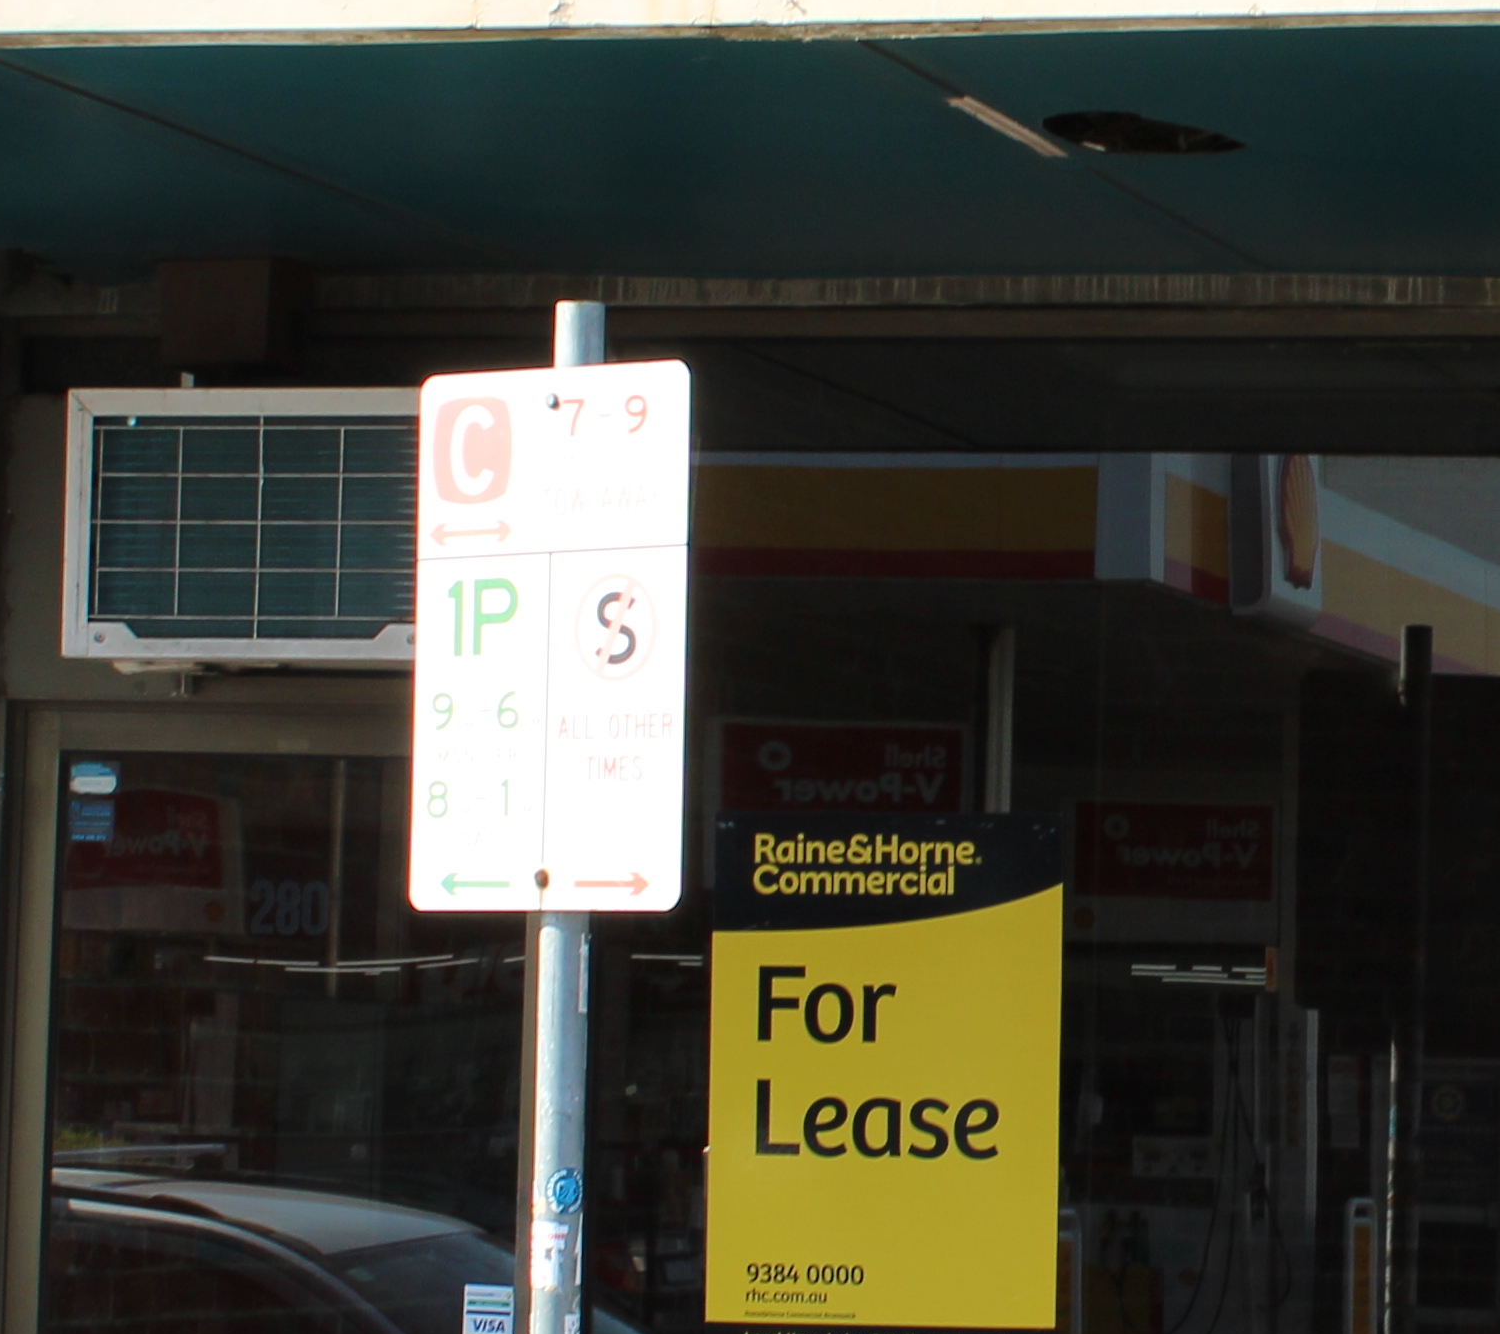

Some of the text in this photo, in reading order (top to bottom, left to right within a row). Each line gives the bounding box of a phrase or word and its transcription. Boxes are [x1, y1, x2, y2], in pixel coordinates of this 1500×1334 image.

[450, 404, 494, 496] C
[447, 577, 519, 657] 1P
[558, 712, 673, 740] ALL OTHER
[586, 755, 643, 781] TIMES
[752, 864, 955, 896] Commercial
[249, 877, 330, 936] 280
[755, 964, 897, 1044] For
[754, 1079, 1001, 1159] Lease
[746, 1264, 865, 1287] 9384 0000
[744, 1287, 828, 1305] rhc.com.au
[472, 1317, 506, 1333] VISA
